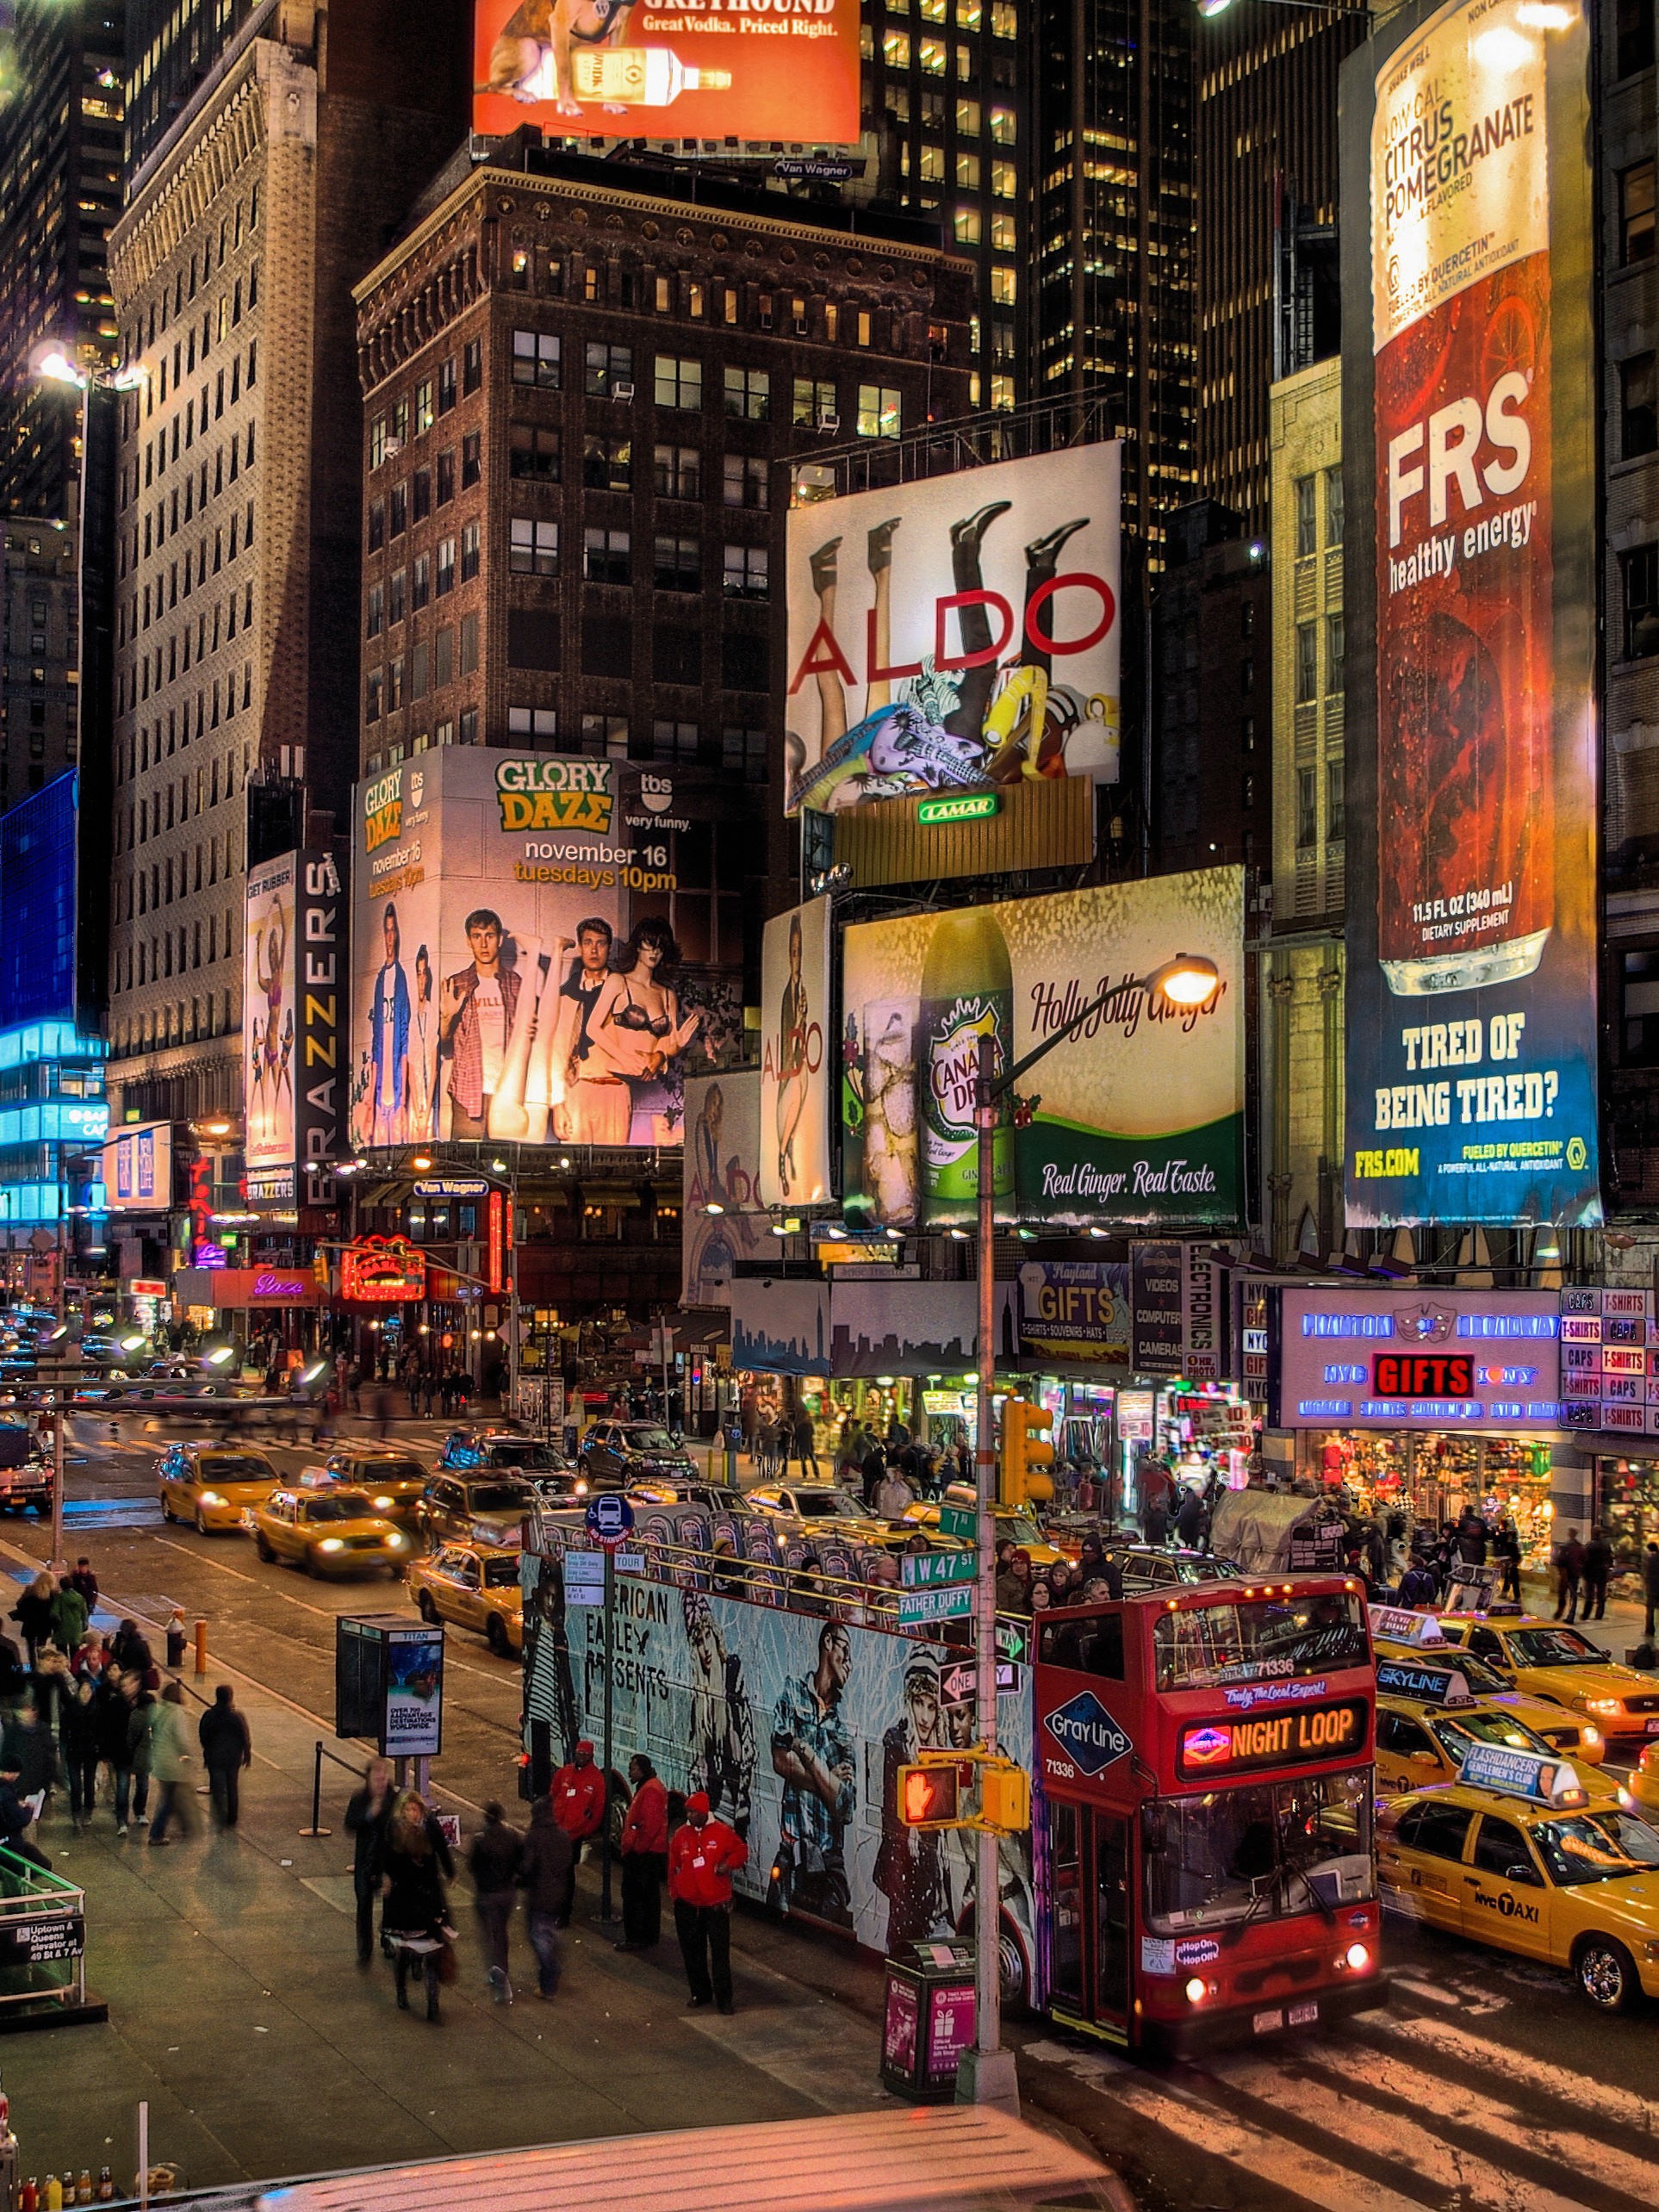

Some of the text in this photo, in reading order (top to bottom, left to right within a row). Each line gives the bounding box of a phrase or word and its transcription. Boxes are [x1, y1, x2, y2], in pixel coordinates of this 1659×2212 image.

[643, 15, 838, 39] Great Vodka. Priced Right.
[1414, 78, 1444, 121] CAL
[1385, 100, 1454, 189] CITRUS
[783, 163, 848, 176] Van Wagner
[1385, 94, 1534, 230] POMEGRANATE
[1389, 371, 1532, 549] FRS
[1389, 500, 1532, 594] healthy energy
[788, 572, 1116, 695] ALDO
[641, 774, 673, 793] tbs
[925, 800, 988, 819] LAMAR
[624, 816, 692, 832] very funny.
[372, 840, 421, 875] november 16
[525, 842, 668, 867] november 16
[369, 873, 402, 899] tuesdays
[514, 861, 677, 893] tuesdays 10pm
[1413, 903, 1432, 923] 11.5
[1432, 900, 1447, 918] FL
[1449, 897, 1464, 916] OZ
[1467, 890, 1490, 914] (340
[1422, 909, 1510, 941] DIETARY SUPPLEMENT
[1030, 979, 1089, 1043] Holly
[1084, 972, 1145, 1039] Jolly
[306, 861, 337, 1205] BRAZZERS
[1402, 1012, 1525, 1071] TIRED OF
[761, 1022, 823, 1084] ALDO
[931, 1034, 1004, 1100] CANAA
[1375, 1071, 1558, 1130] BEING TIRED?
[1463, 1144, 1507, 1159] FUELED BY
[1355, 1148, 1420, 1178] FRS.COM
[1443, 1163, 1475, 1174] POWERFUL
[247, 1181, 294, 1201] BRAZZERS
[419, 1183, 485, 1196] Van Wagner
[1042, 1160, 1215, 1203] Real Ginger. Real Taste.
[1146, 1278, 1179, 1293] VIDEOS
[1039, 1285, 1115, 1324] GIFTS
[1190, 1246, 1212, 1350] ELECTRONICS
[1569, 1293, 1643, 1312] CAPS T-SHIRTS
[1022, 1323, 1047, 1336] T-SHIRTS
[1085, 1327, 1103, 1339] HATS
[1563, 1321, 1600, 1339] T-SHIRTS
[1610, 1322, 1636, 1340] CAPS
[1139, 1341, 1183, 1357] CAMERAS
[1568, 1349, 1593, 1367] CAPS
[1604, 1351, 1643, 1370] T-SHIRTS
[1187, 1366, 1216, 1376] PHOTO
[1199, 1357, 1215, 1366] HR.
[1324, 1365, 1367, 1383] NYC
[1379, 1358, 1469, 1395] GIFTS
[1502, 1366, 1538, 1385] NY
[1563, 1377, 1600, 1395] T-SHIRTS
[1610, 1380, 1636, 1397] CAPS
[1568, 1405, 1593, 1422] CAPS
[1604, 1407, 1643, 1426] T-SHIRTS
[951, 1511, 960, 1532] 7
[617, 1556, 640, 1568] TOUR
[918, 1552, 973, 1581] W 47 ST
[899, 1590, 971, 1615] FATHER DUFFY
[922, 1607, 948, 1619] SQUARE
[1255, 1658, 1295, 1678] 71336
[950, 1673, 972, 1691] ONE
[1267, 1683, 1291, 1700] Local
[1291, 1681, 1326, 1698] Expert!
[1378, 1667, 1447, 1693] SKYLINE
[1052, 1713, 1125, 1752] Gray Line
[1232, 1708, 1353, 1758] NIGHT LOOP
[1046, 1758, 1075, 1779] 71336
[1468, 1746, 1540, 1774] FLASHDANCERS
[1467, 1760, 1514, 1780] GENTLEMEN'S
[1514, 1771, 1533, 1785] CLUB
[1475, 1892, 1539, 1923] NYC TAXI
[30, 1921, 74, 1936] Uptown &
[30, 1933, 65, 1943] Queens
[30, 1938, 78, 1953] elevator at
[30, 1947, 83, 1961] 49 St & 7 Av
[1184, 1941, 1201, 1952] Hop
[1200, 1939, 1213, 1948] On
[1184, 1952, 1214, 1965] Hop Off
